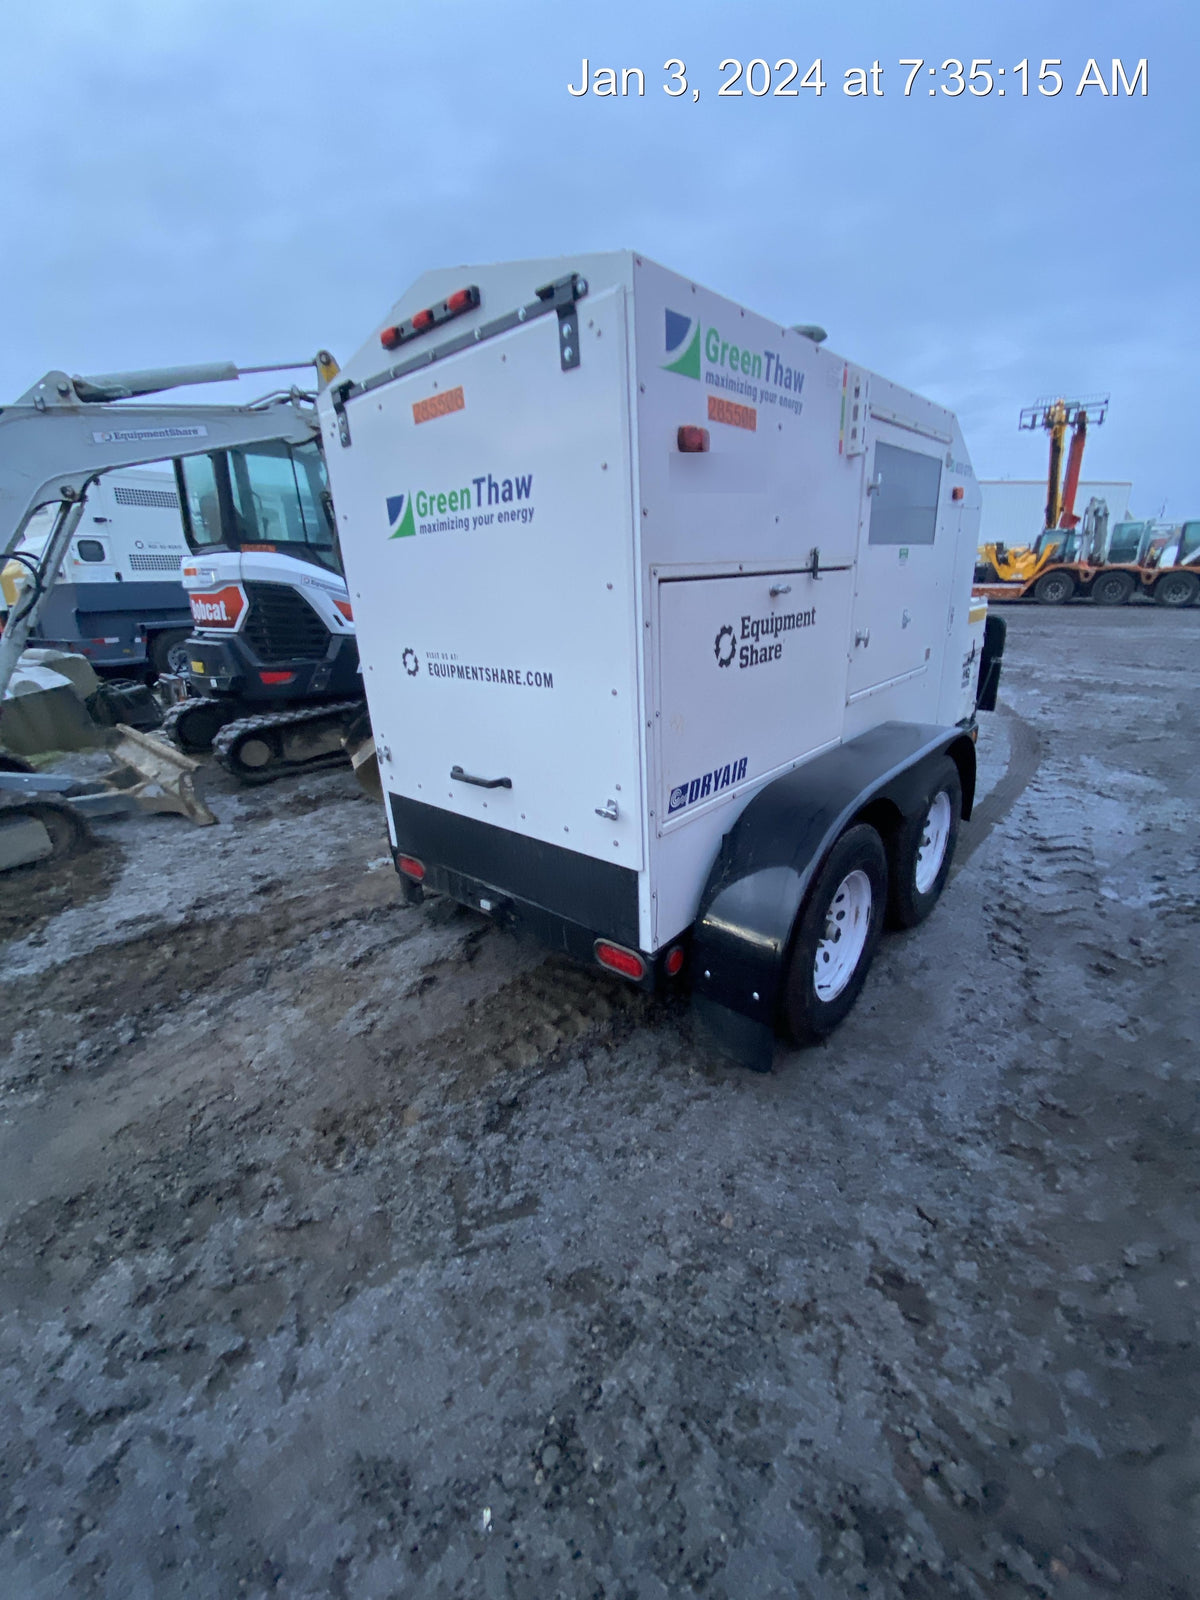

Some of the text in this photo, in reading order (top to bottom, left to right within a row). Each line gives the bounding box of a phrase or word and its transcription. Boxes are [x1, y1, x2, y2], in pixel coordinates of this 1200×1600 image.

[705, 371, 803, 415] maximizing your energy
[114, 428, 199, 440] EquipmentShare
[419, 506, 535, 536] maximizing your energy
[740, 606, 816, 642] Equipment
[739, 643, 782, 669] Share
[428, 662, 554, 688] EQUIPMENTSHARE.COM
[688, 756, 748, 804] DRYAIR
